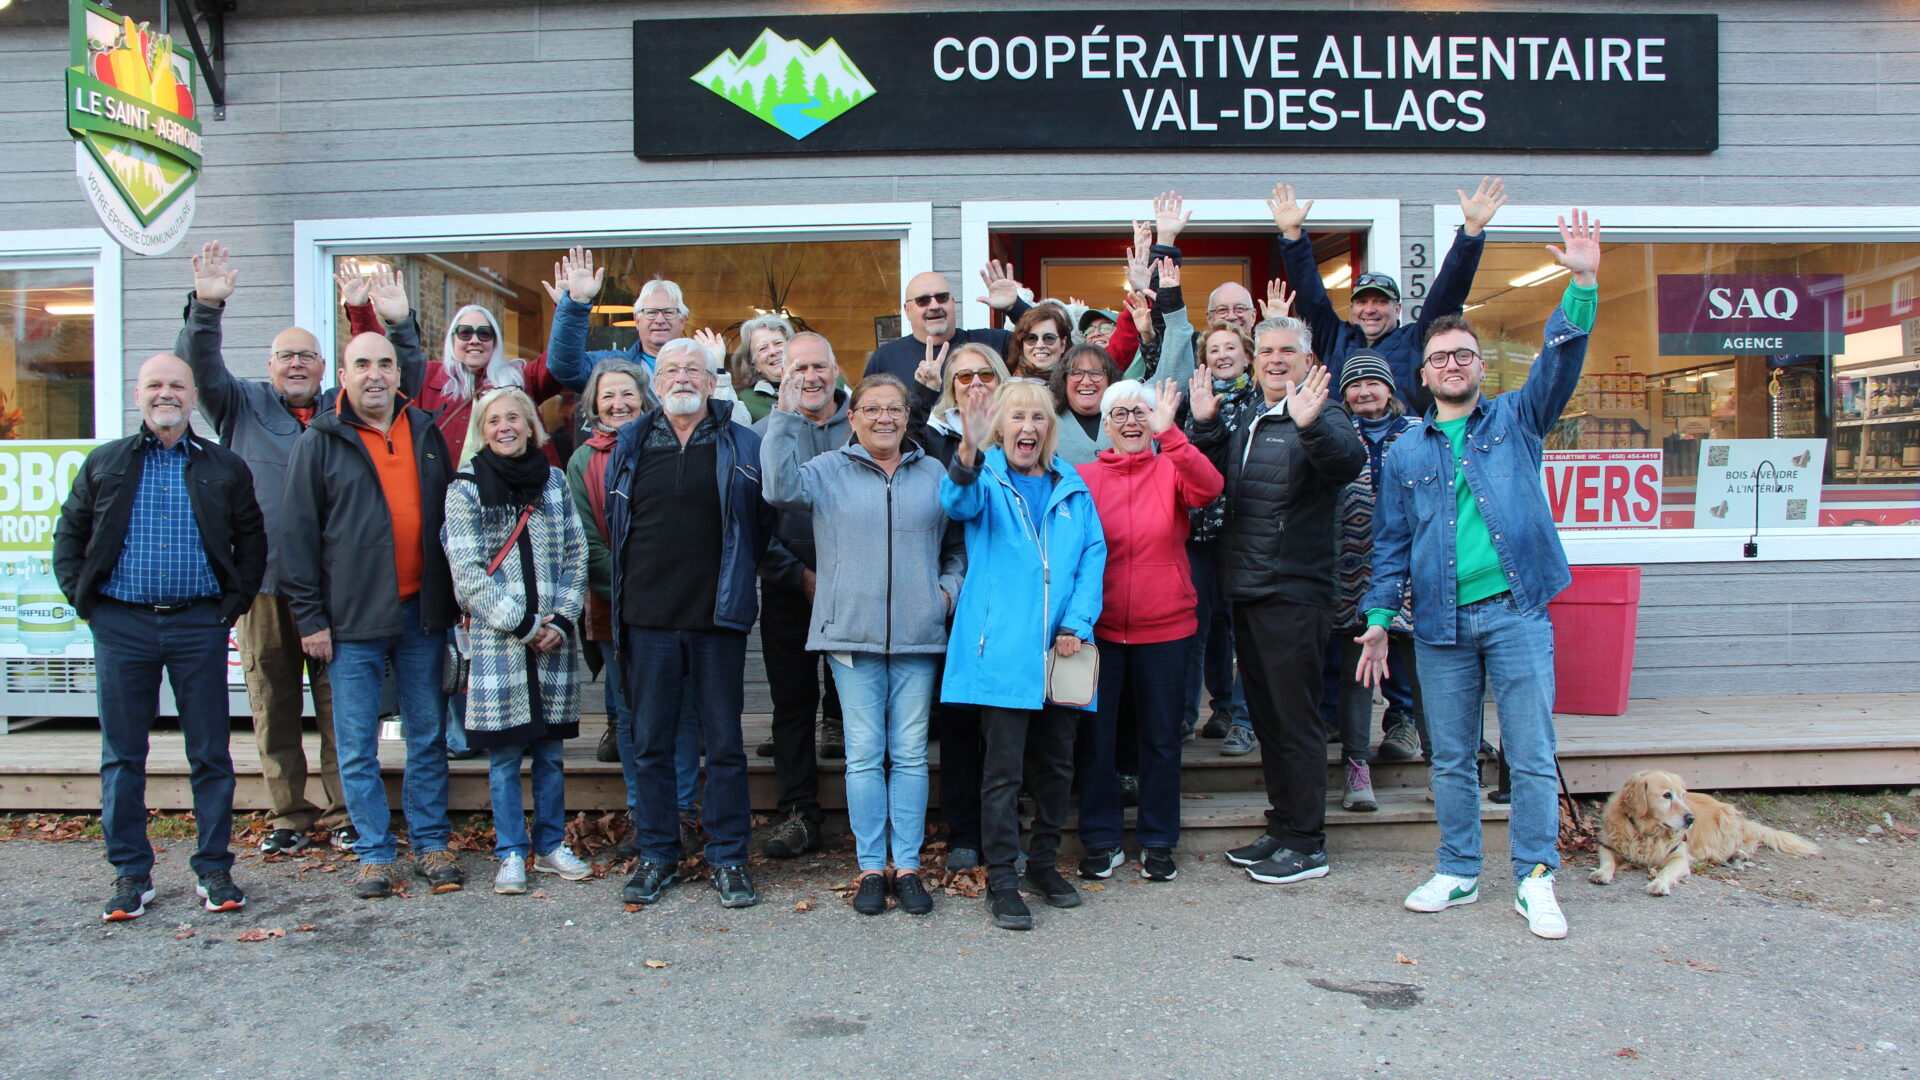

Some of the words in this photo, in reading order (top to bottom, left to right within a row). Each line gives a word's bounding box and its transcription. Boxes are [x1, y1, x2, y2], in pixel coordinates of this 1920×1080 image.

[933, 25, 1300, 82] COOPÉRATIVE
[1312, 34, 1667, 82] ALIMENTAIRE
[75, 86, 103, 117] LE
[1122, 88, 1487, 133] VAL-DES-LACS
[87, 170, 110, 213] VOTRE
[107, 207, 141, 244] ÉPICERIE
[140, 200, 192, 246] COMMUNAUTAIRE
[1708, 287, 1799, 321] SAQ
[1722, 337, 1783, 349] AGENCE
[1725, 470, 1748, 480] BOIS
[1750, 468, 1758, 480] À
[1760, 470, 1798, 479] VENDRE
[1727, 483, 1734, 493] À
[1736, 483, 1794, 494] L'INTÉRIUR
[1544, 464, 1659, 523] VERS
[0, 515, 62, 543] ROP
